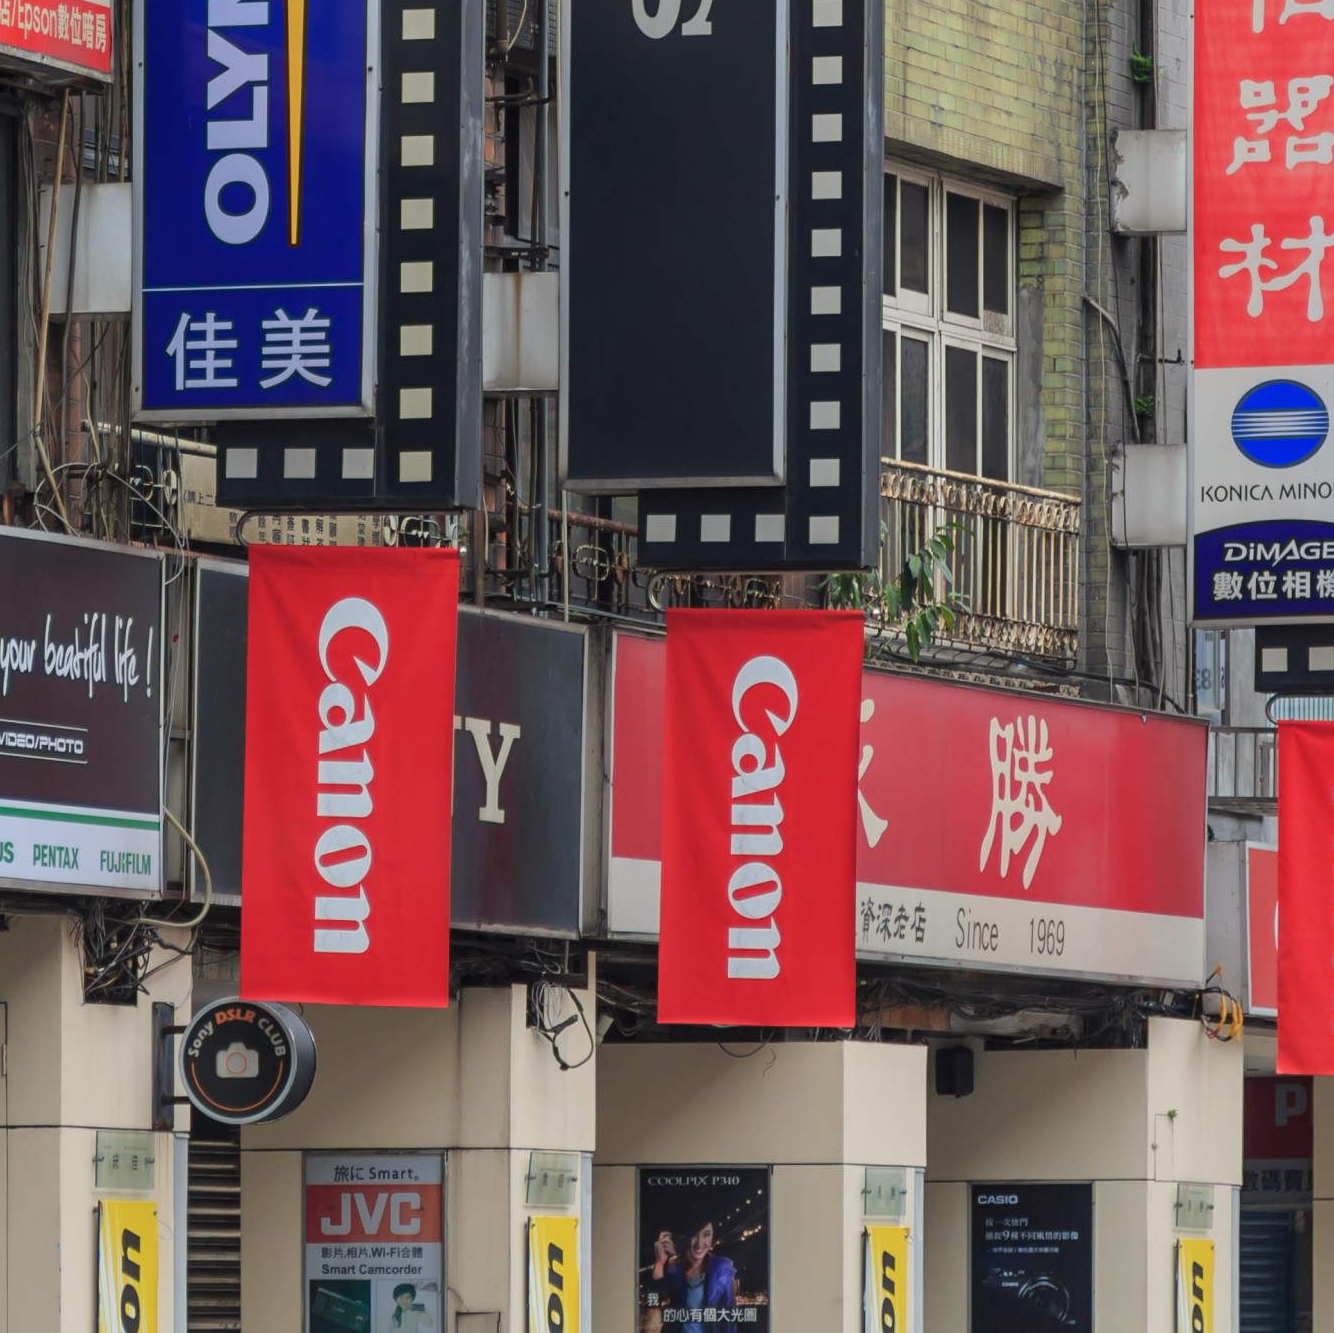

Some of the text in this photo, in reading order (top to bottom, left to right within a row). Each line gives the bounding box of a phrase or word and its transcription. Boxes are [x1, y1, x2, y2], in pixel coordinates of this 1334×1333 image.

[166, 308, 333, 394] 佳美
[1201, 483, 1273, 503] KONICA
[0, 637, 36, 697] your
[115, 614, 139, 704] life
[313, 597, 389, 954] Canon
[727, 655, 798, 980] Canon
[33, 843, 79, 870] PENTAX
[100, 850, 151, 875] FUJIFILM
[856, 897, 1065, 956] 資深老店 Since 1969
[188, 1008, 286, 1058] Sony DSLR CLUB
[334, 1166, 364, 1182] 旅に
[648, 1175, 740, 1187] COOLPIX P310
[321, 1192, 421, 1235] JVC
[977, 1194, 1018, 1206] CASIO
[322, 1264, 423, 1275] Smart Camcorder
[664, 1308, 757, 1324] 的心有個大光圈
